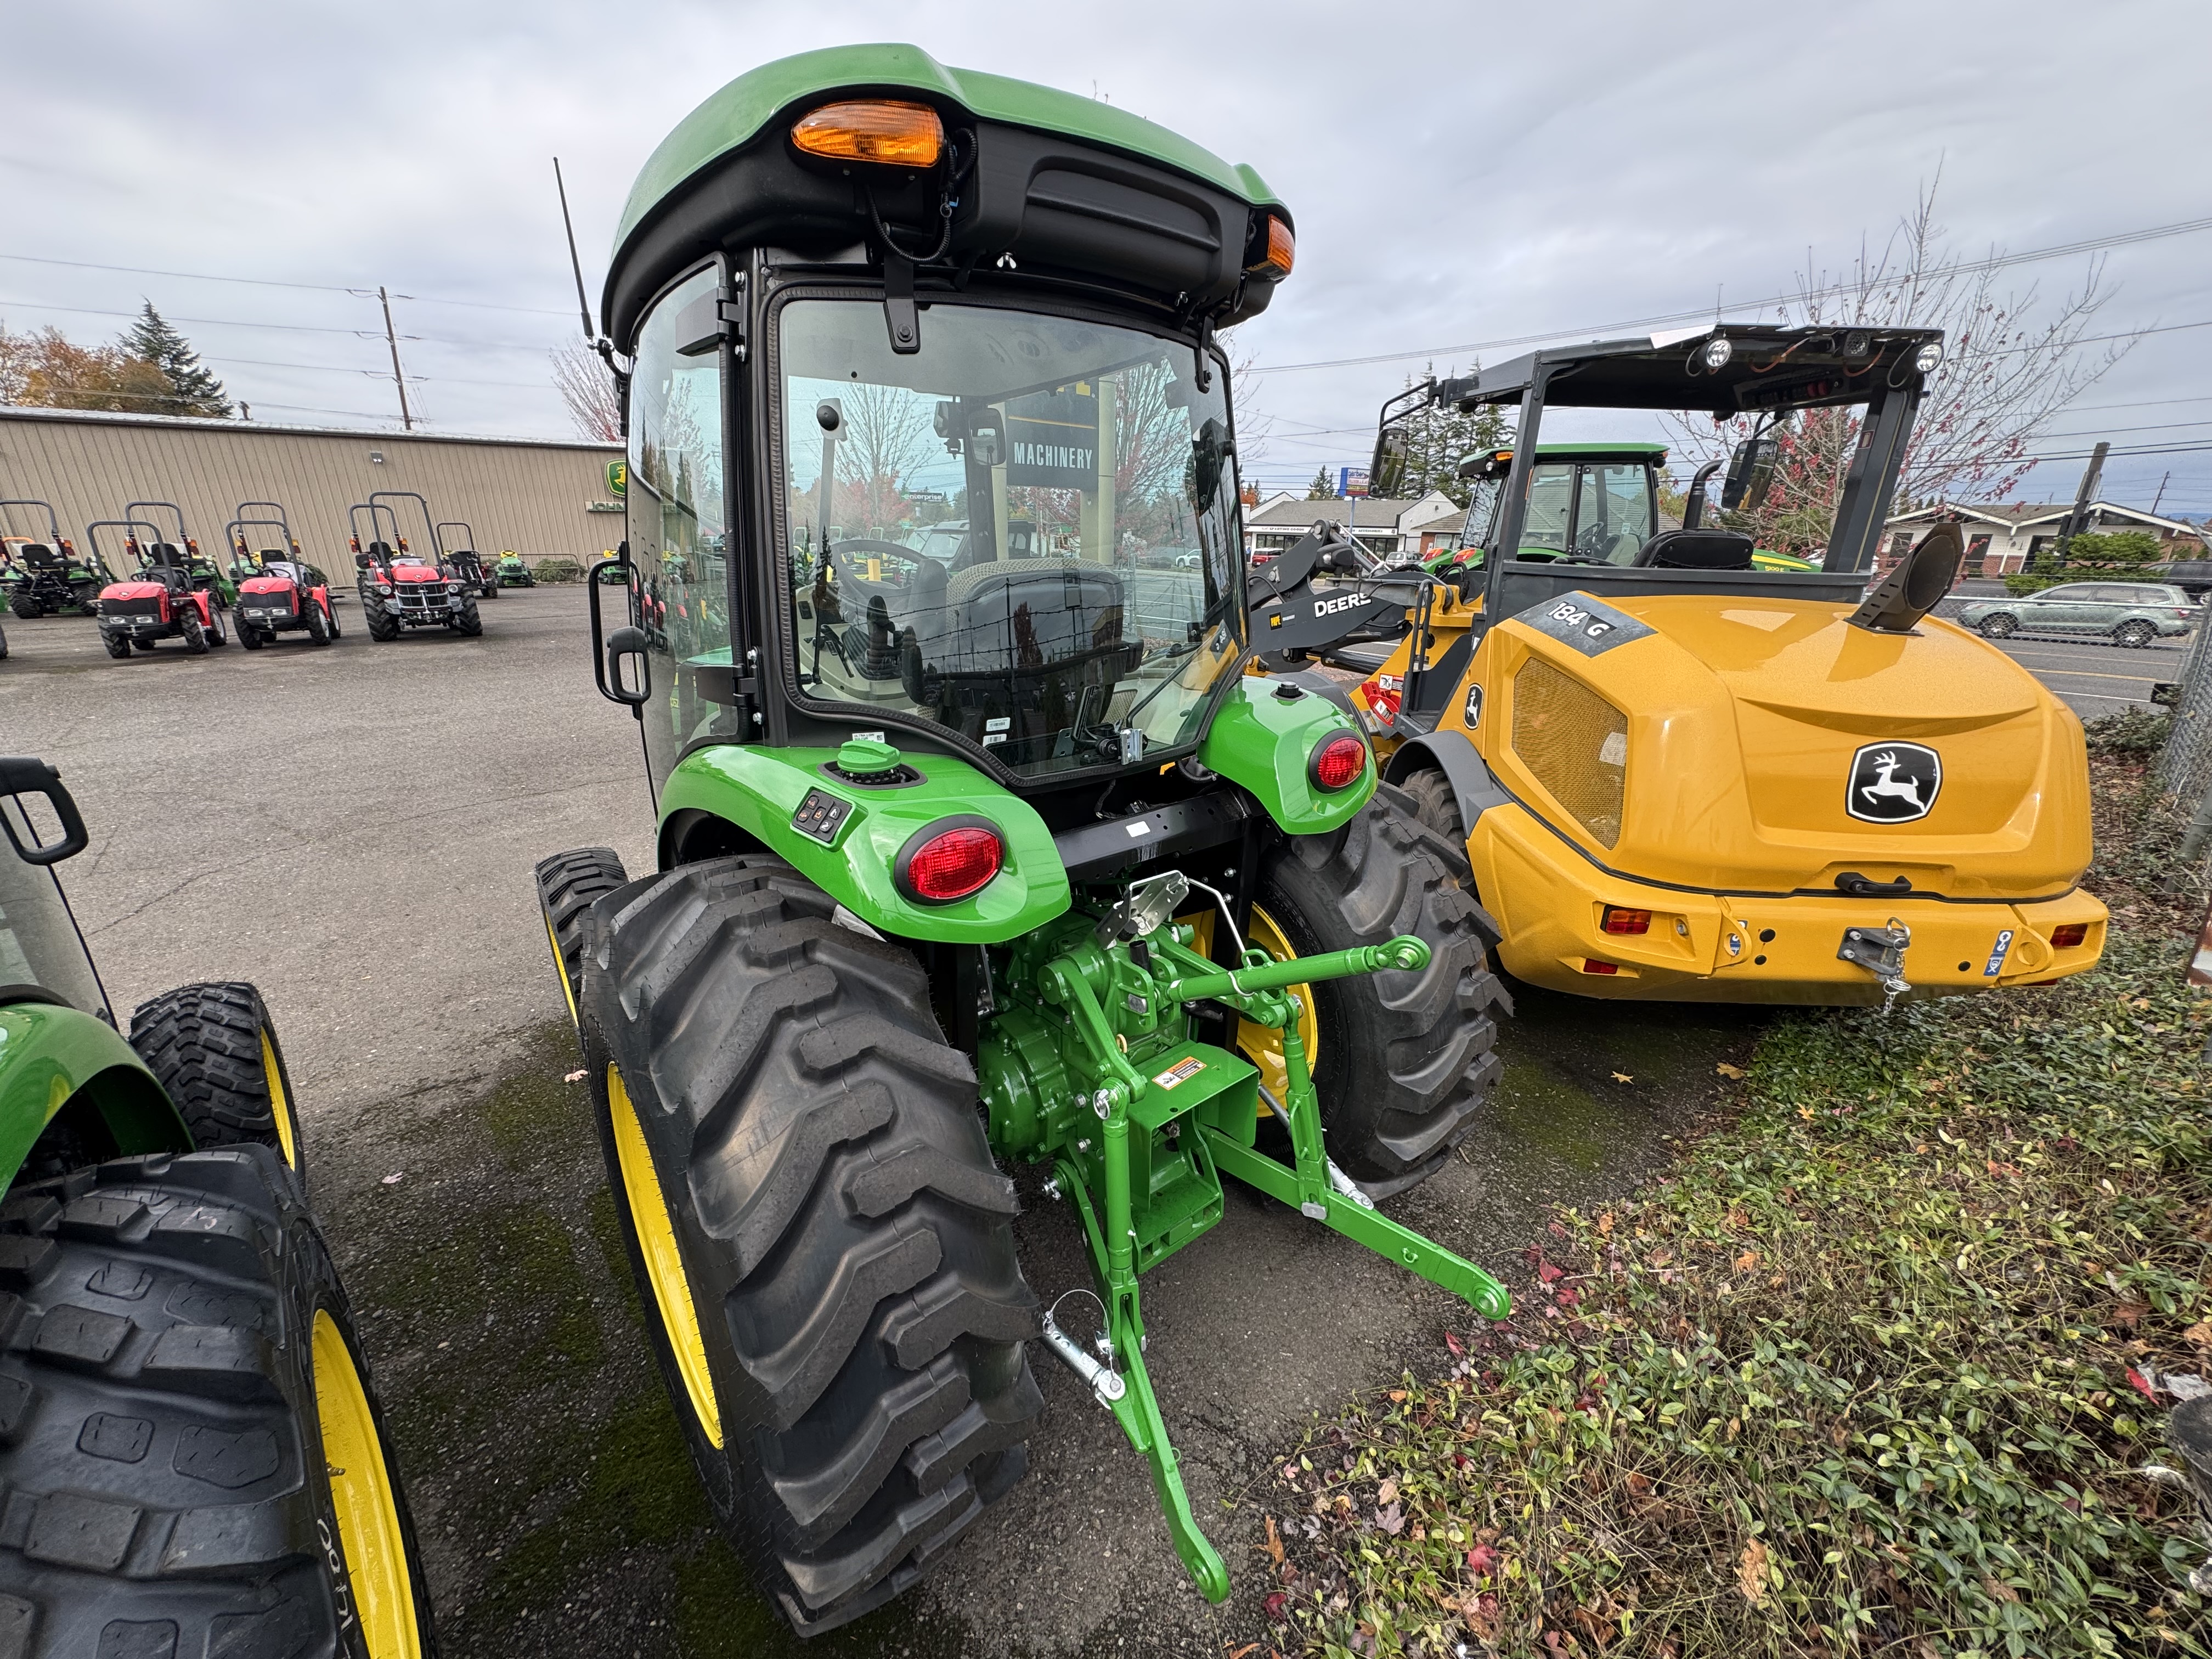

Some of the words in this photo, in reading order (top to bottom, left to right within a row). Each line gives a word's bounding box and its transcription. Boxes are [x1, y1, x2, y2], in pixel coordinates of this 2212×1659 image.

[1014, 442, 1093, 470] MACHINERY
[1548, 602, 1590, 627] 184
[1587, 623, 1610, 636] G
